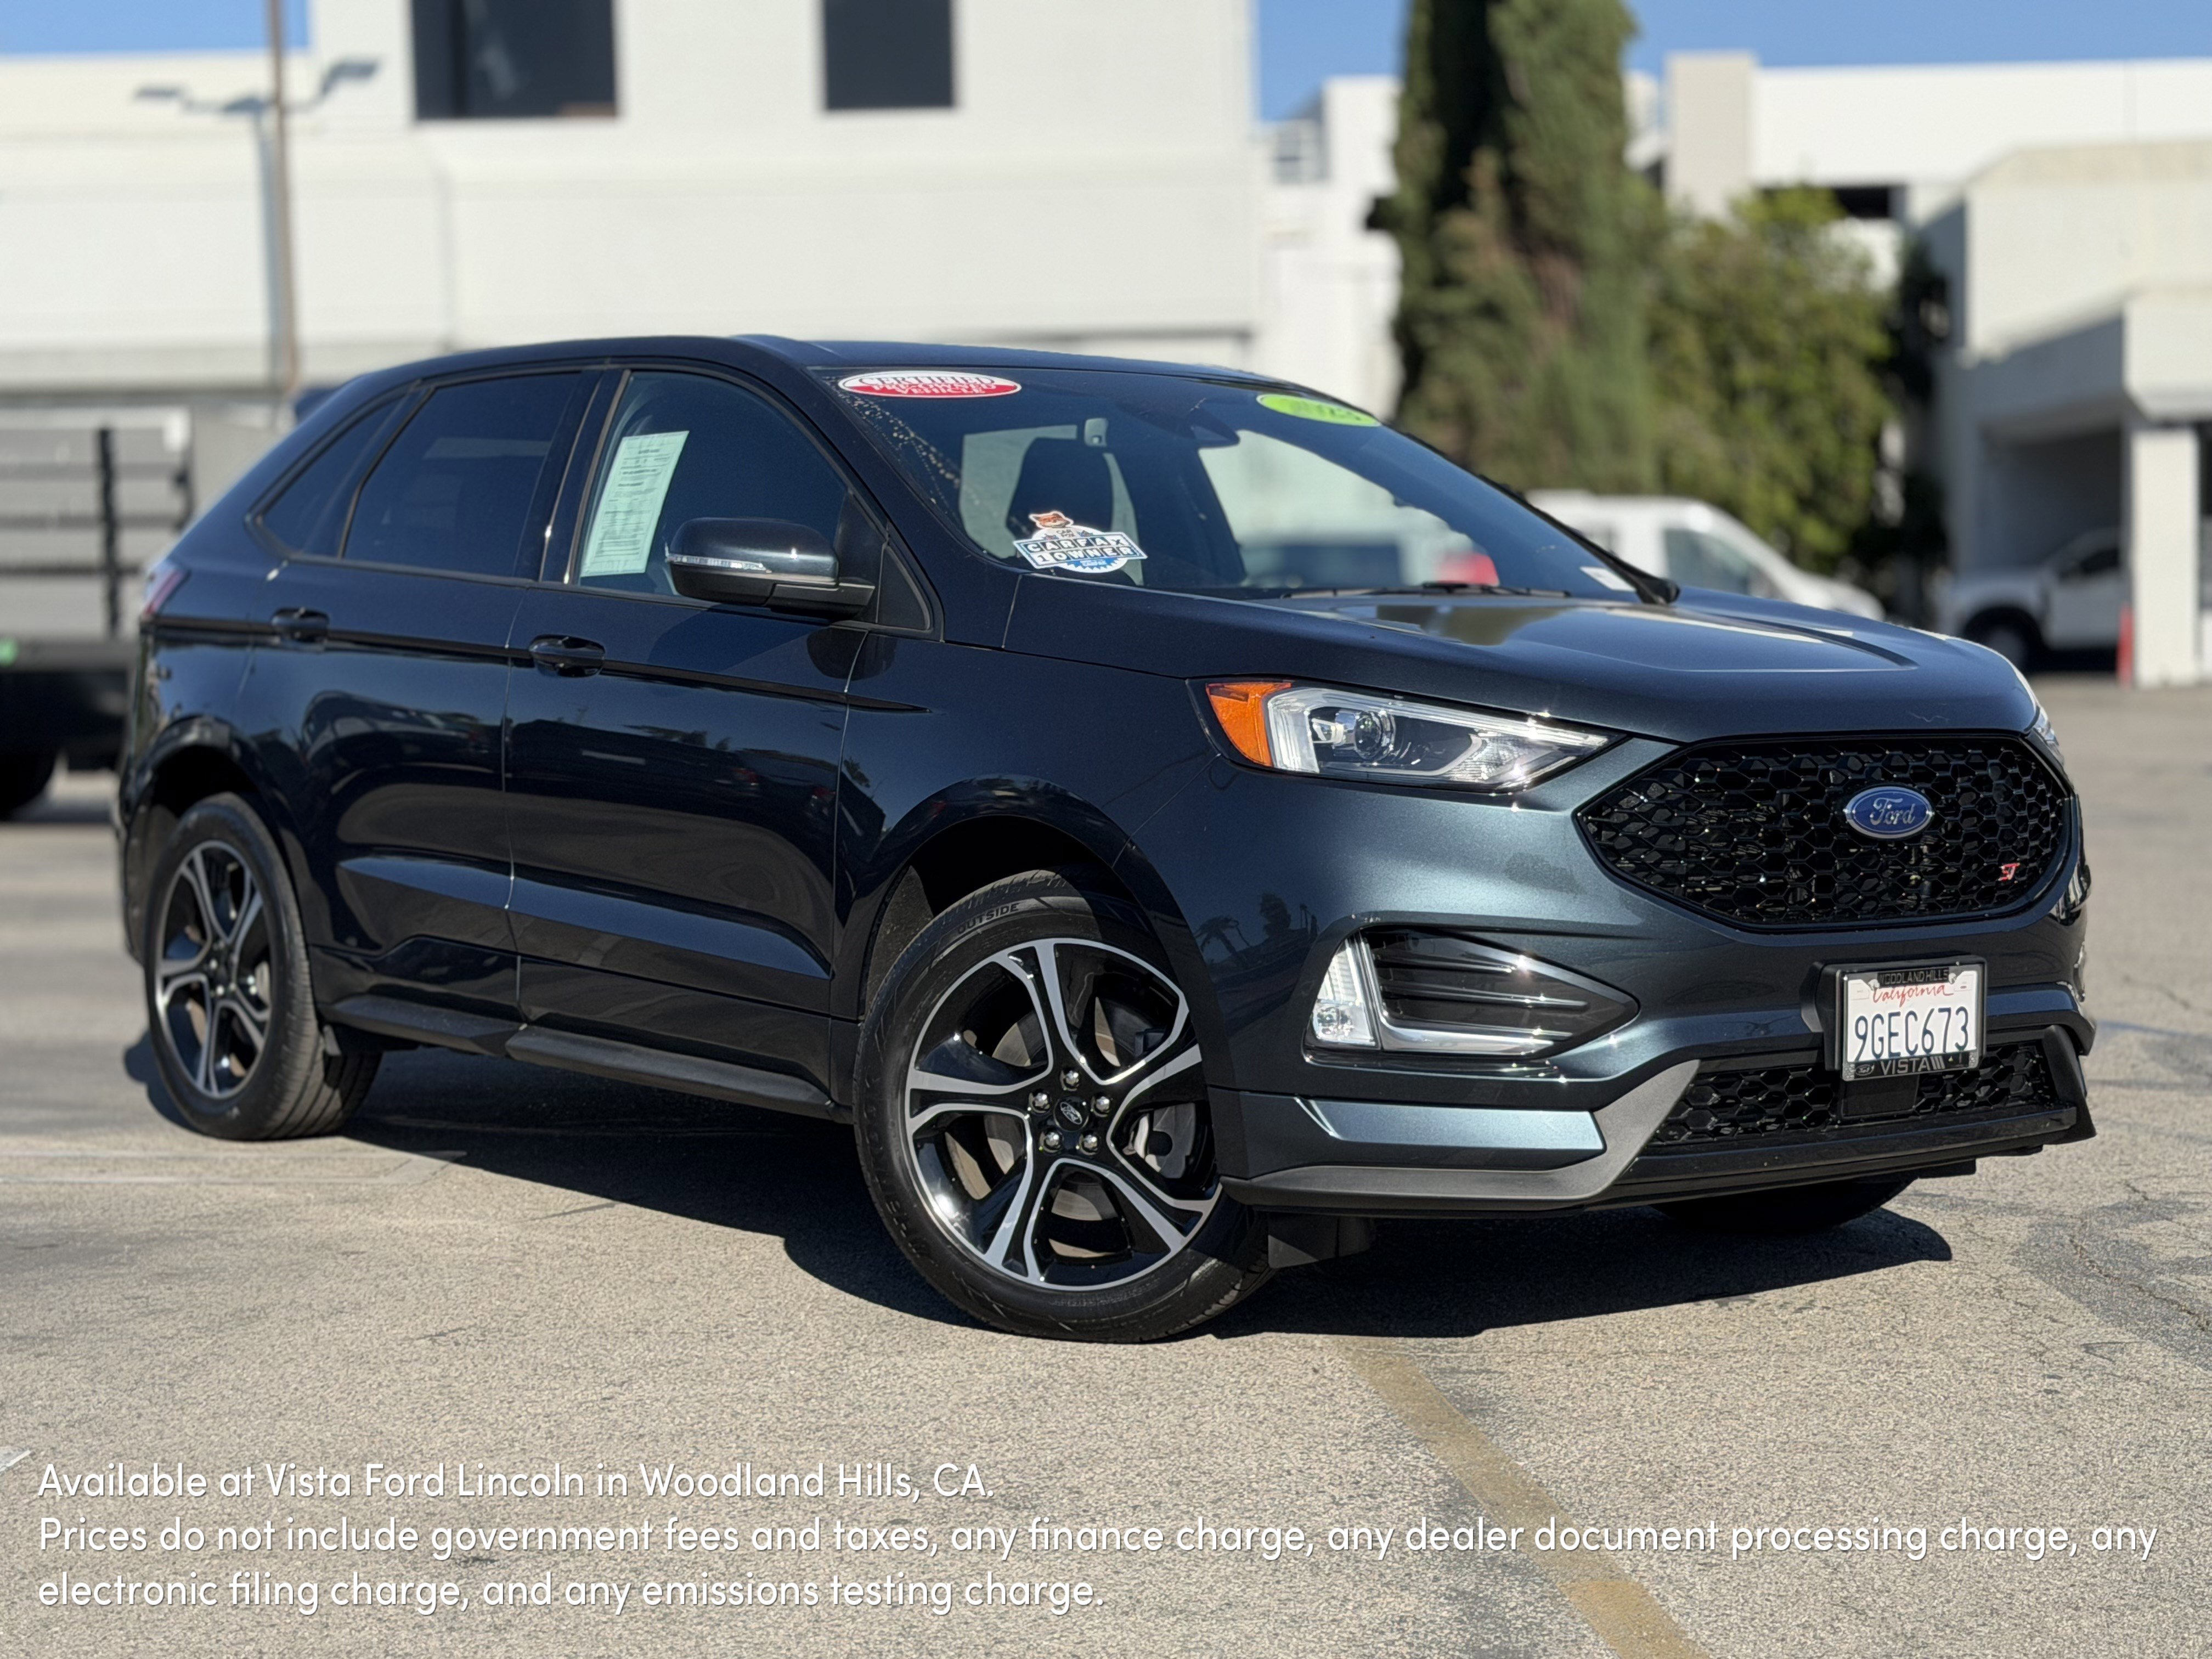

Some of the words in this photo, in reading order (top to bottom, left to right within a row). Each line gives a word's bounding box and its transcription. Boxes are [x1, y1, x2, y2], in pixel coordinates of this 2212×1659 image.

[859, 376, 995, 385] CERTIFIED
[1028, 538, 1127, 553] CARFAX
[1054, 546, 1134, 561] OWNER
[1870, 797, 1916, 826] Ford
[957, 902, 1020, 934] OUTSIDE
[1880, 970, 1925, 985] WOODLAND
[1926, 969, 1948, 981] HILLS
[1872, 984, 1954, 1007] California
[1854, 1006, 1970, 1062] 9GEC673
[1880, 1057, 1930, 1076] VISTA
